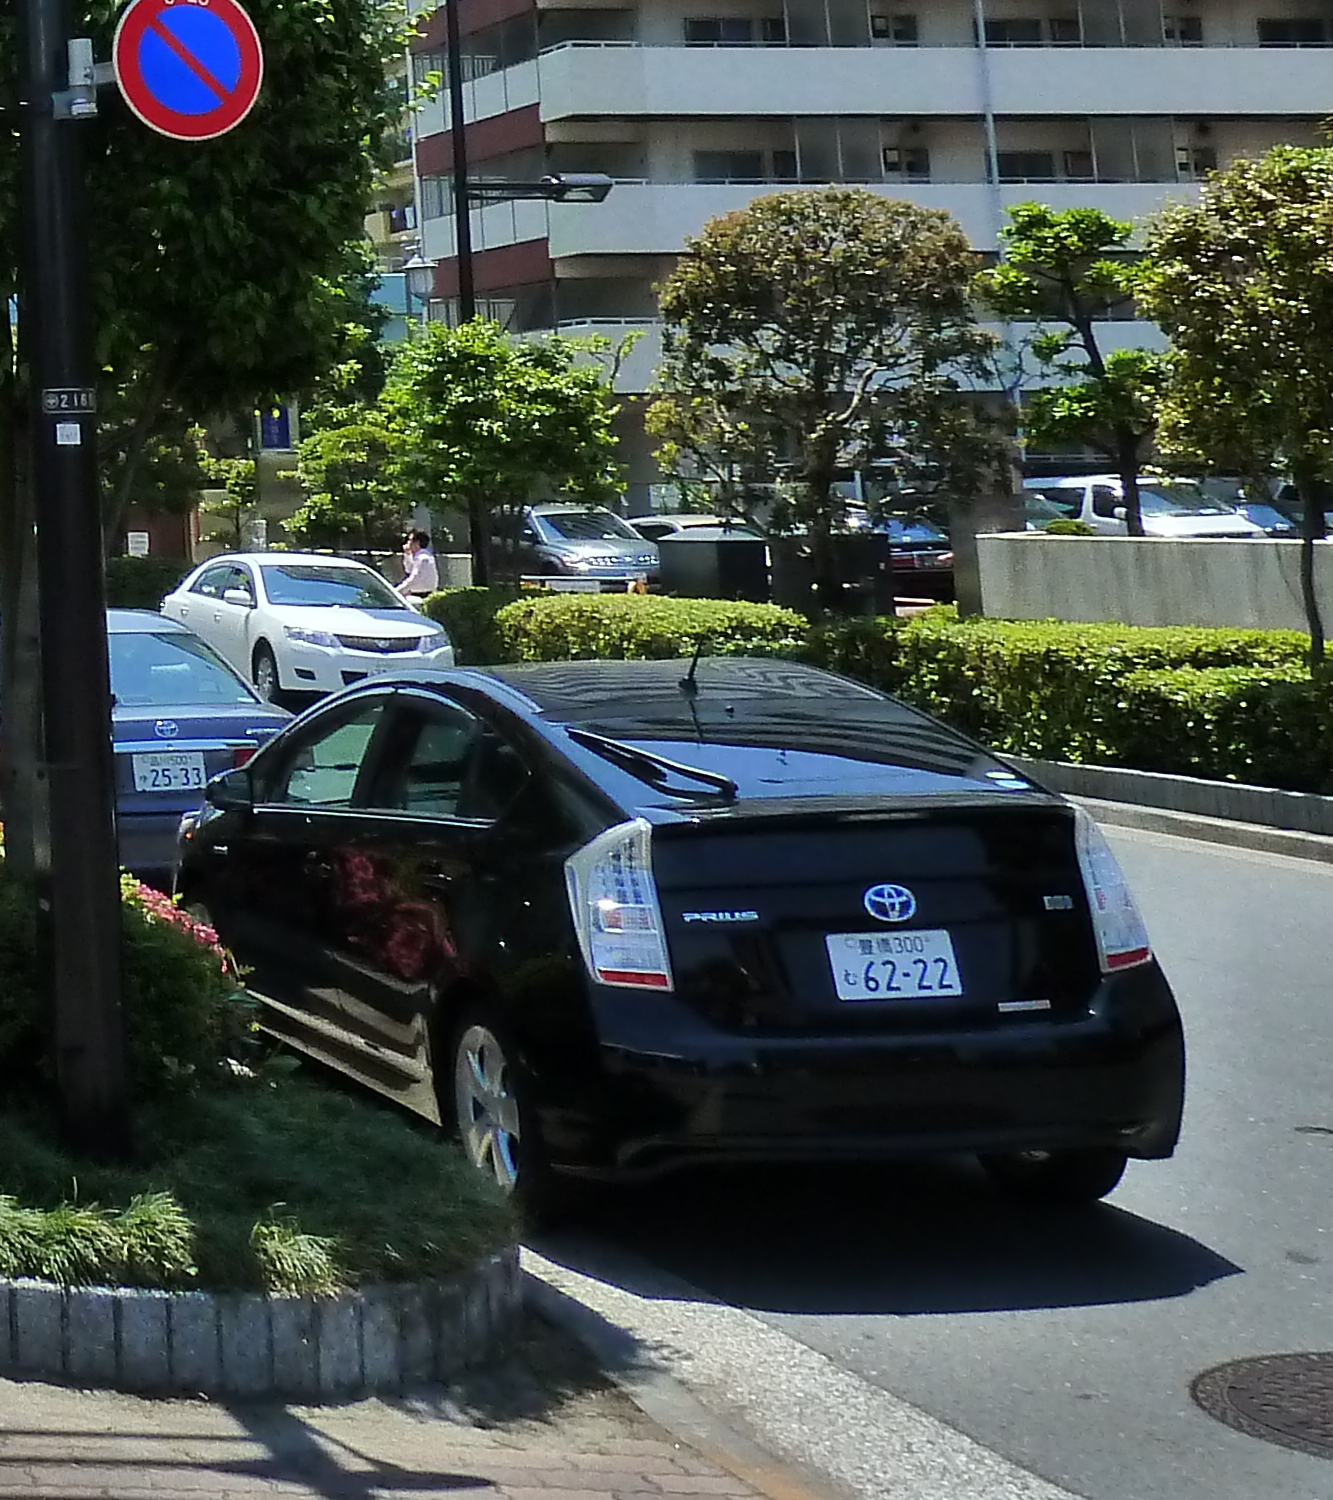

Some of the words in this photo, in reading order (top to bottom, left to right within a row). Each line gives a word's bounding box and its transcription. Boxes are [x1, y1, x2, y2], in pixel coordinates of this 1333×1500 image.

[150, 767, 202, 787] 25-33
[681, 911, 759, 923] PRIUS
[864, 957, 953, 992] 62-22
